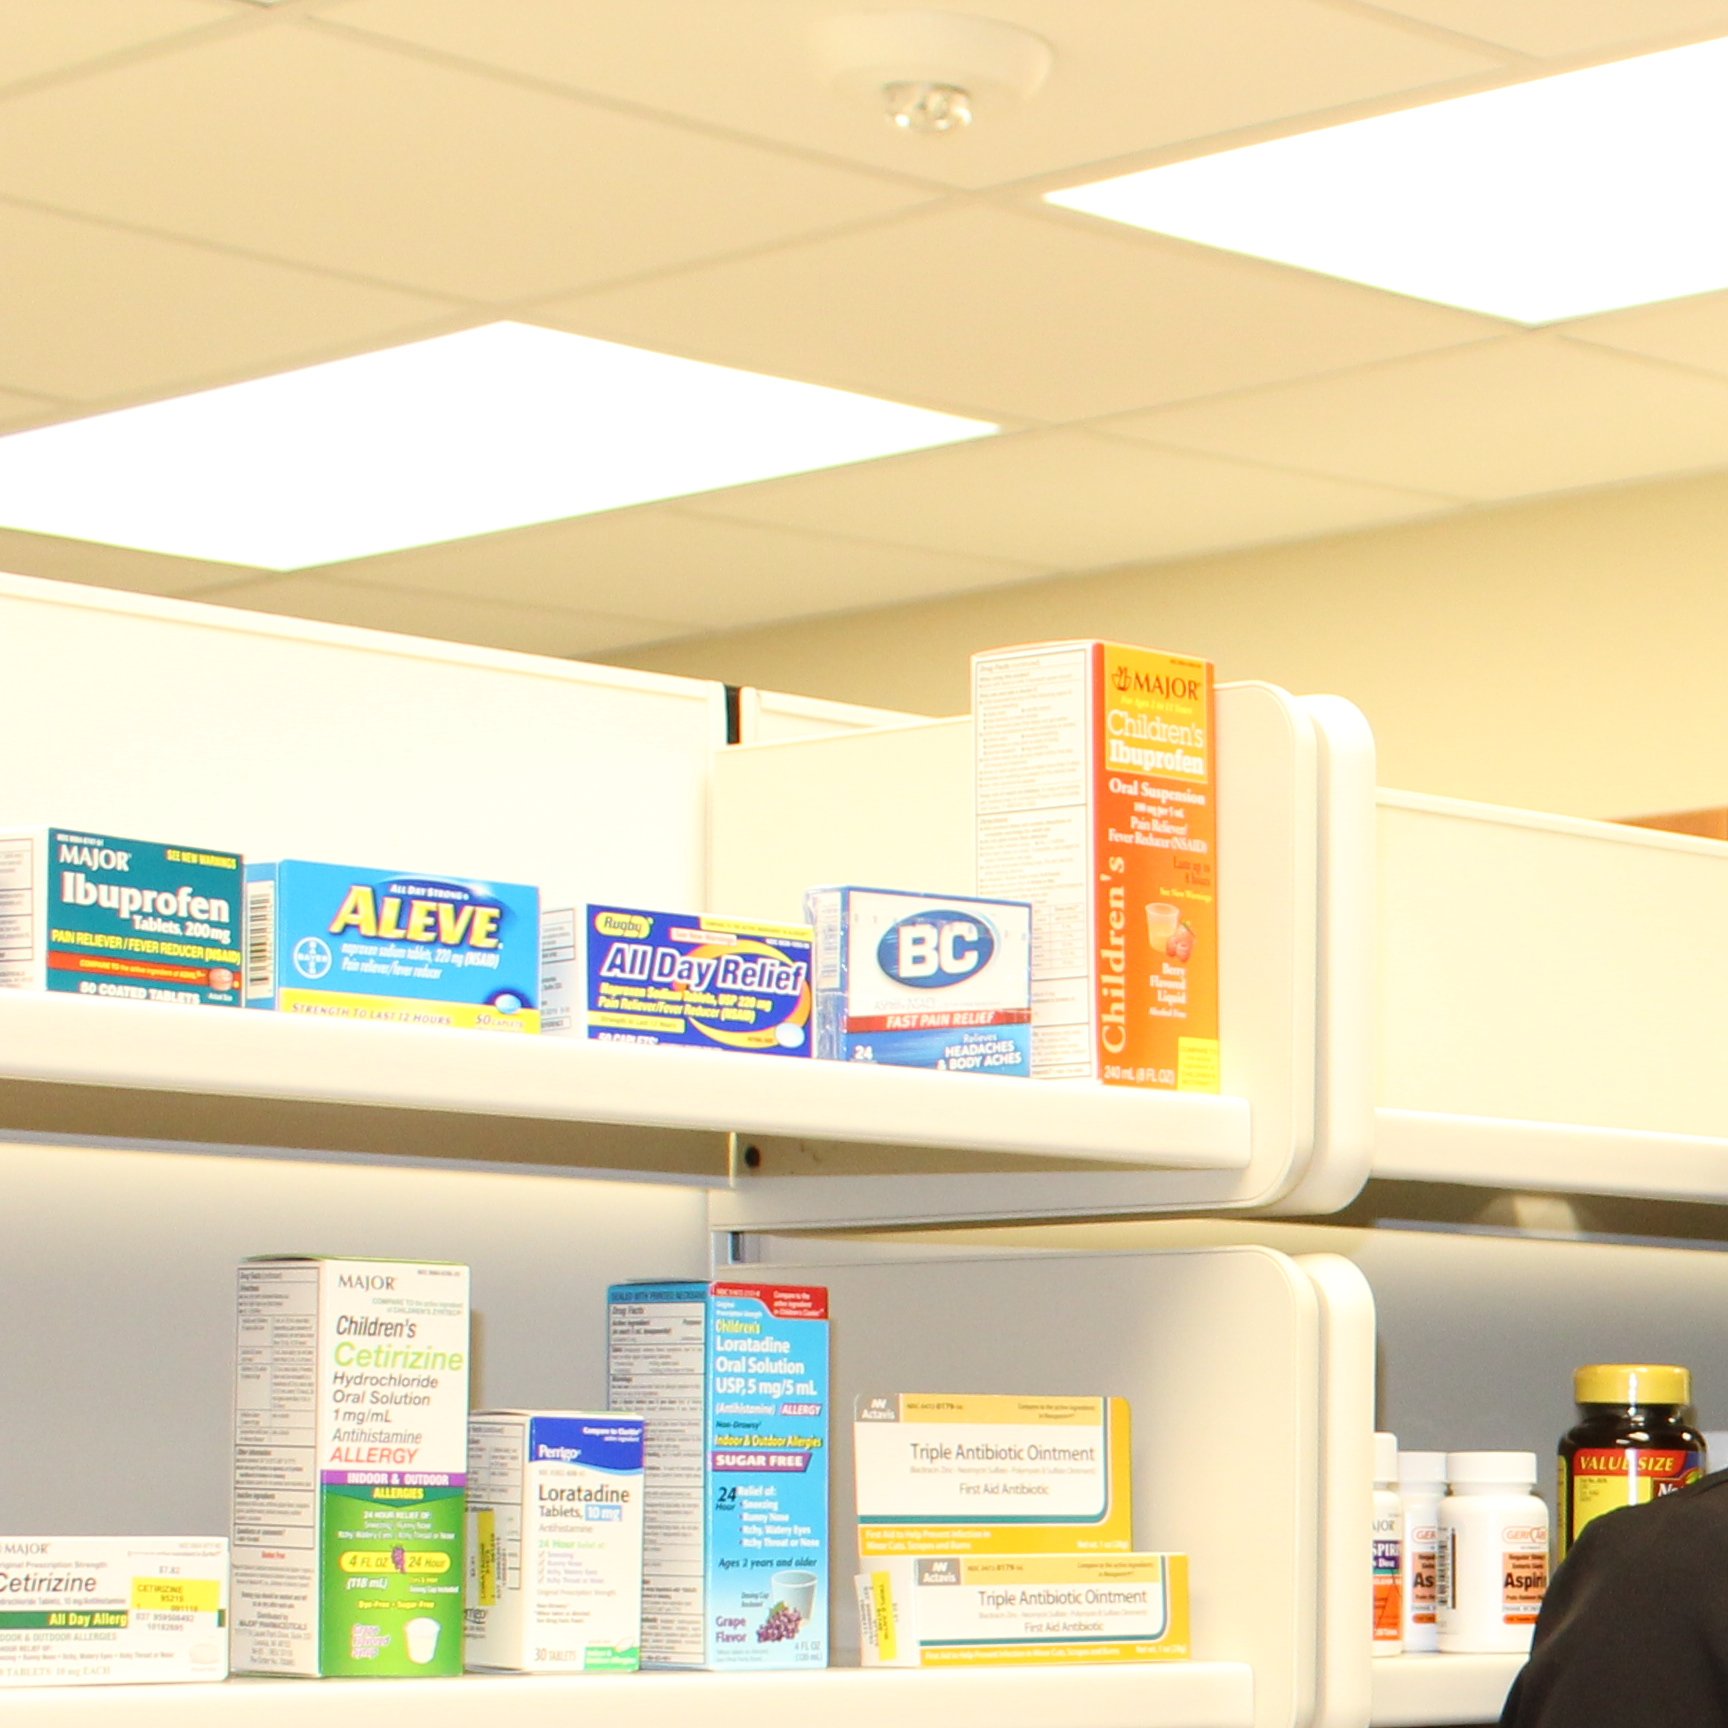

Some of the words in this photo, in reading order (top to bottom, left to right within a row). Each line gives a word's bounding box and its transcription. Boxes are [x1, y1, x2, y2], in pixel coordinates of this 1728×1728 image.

[1133, 672, 1202, 700] MAJOR
[1107, 709, 1204, 748] Children's
[1109, 739, 1205, 775] Ibuprofen
[1109, 777, 1139, 796] Oral
[1141, 782, 1206, 805] Suspension
[58, 844, 131, 871] MAJOR
[61, 871, 230, 923] Ibuprofen
[329, 885, 503, 949] ALEVE
[604, 916, 643, 933] Rugby
[132, 915, 183, 936] Tablets,
[185, 921, 231, 944] 200mg
[51, 928, 75, 945] PAIN
[76, 931, 123, 950] RELIEVER
[128, 937, 160, 954] FEVER
[160, 940, 204, 959] REDUCER
[899, 921, 980, 978] BC
[1101, 856, 1126, 1054] Children's
[602, 943, 652, 980] All
[654, 948, 717, 991] Day
[717, 954, 807, 995] Relief
[886, 1015, 918, 1029] FAST
[920, 1013, 950, 1027] PAIN
[952, 1010, 996, 1025] RELIEF
[855, 1045, 873, 1060] 24
[944, 1040, 1015, 1058] HEADACHES
[949, 1056, 982, 1071] BODY
[983, 1051, 1022, 1067] ACHES
[338, 1274, 397, 1291] MAJOR
[336, 1315, 417, 1339] Children's
[715, 1319, 761, 1335] Children's
[716, 1336, 791, 1354] Loratadine
[334, 1341, 464, 1371] Cetirizine
[716, 1357, 746, 1373] Oral
[748, 1357, 805, 1375] Solution
[332, 1371, 438, 1389] Hydrochloride
[716, 1377, 746, 1396] USP,
[748, 1378, 757, 1395] 5
[759, 1378, 794, 1399] mg/5
[795, 1379, 818, 1396] mL
[332, 1389, 366, 1404] Oral
[369, 1391, 431, 1406] Solution
[341, 1409, 392, 1425] mg/mL
[862, 1409, 896, 1421] Actavis
[332, 1428, 422, 1444] Antihistamine
[330, 1446, 419, 1465] ALLERGY
[538, 1444, 581, 1462] Perrigo
[716, 1454, 767, 1467] SUGAR
[769, 1454, 803, 1467] FREE
[910, 1443, 953, 1462] Triple
[955, 1443, 1024, 1461] Antibiotic
[1027, 1444, 1095, 1462] Ointment
[1580, 1455, 1629, 1471] VALUE
[1637, 1457, 1675, 1472] SIZE
[347, 1472, 387, 1485] INDOOR
[391, 1472, 399, 1485] &
[404, 1473, 449, 1486] OUTDOOR
[538, 1484, 631, 1503] Loratadine
[718, 1486, 737, 1502] 24
[959, 1482, 981, 1495] First
[983, 1482, 1000, 1495] Aid
[1002, 1482, 1049, 1495] Antibiotic
[539, 1506, 583, 1520] Tablets,
[588, 1506, 599, 1518] 10
[601, 1508, 620, 1522] mg
[922, 1572, 957, 1584] Actavis
[978, 1590, 1016, 1607] Triple
[1018, 1590, 1083, 1606] Antibiotic
[1085, 1589, 1147, 1605] Ointment
[49, 1612, 67, 1626] All
[69, 1613, 91, 1628] Day
